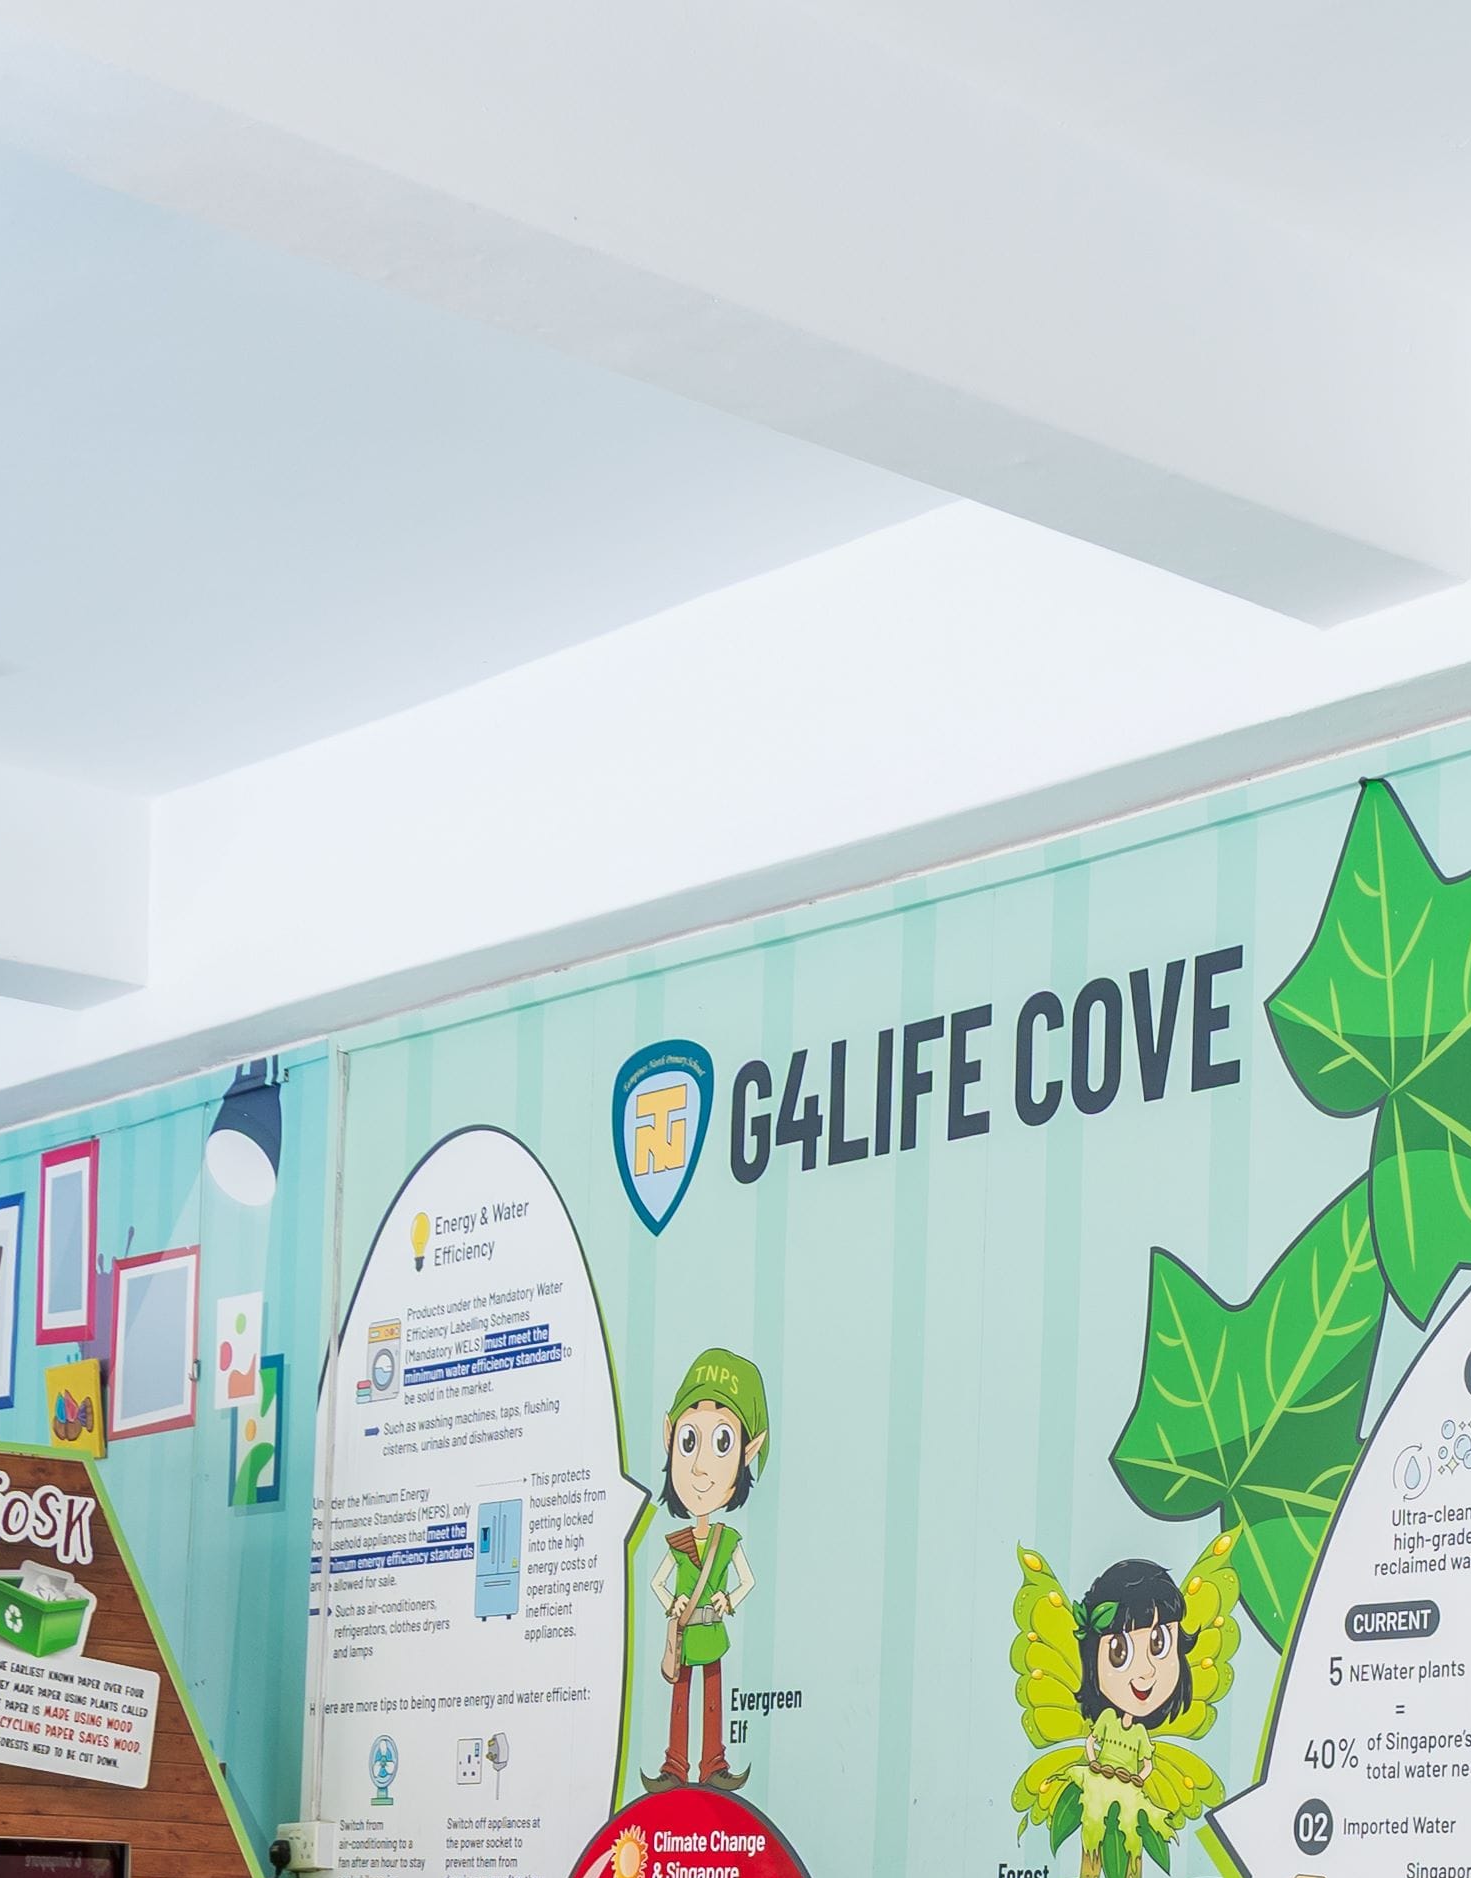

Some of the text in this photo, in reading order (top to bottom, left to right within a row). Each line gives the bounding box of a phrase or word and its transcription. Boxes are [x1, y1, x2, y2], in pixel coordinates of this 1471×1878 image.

[730, 945, 1243, 1184] G4LIFE COVE
[436, 1203, 529, 1235] Energy & Water
[435, 1241, 494, 1266] Efficiency
[695, 1364, 740, 1395] TNPS
[531, 1469, 590, 1487] This protects
[1353, 1609, 1431, 1633] CURRENT
[11, 1663, 44, 1677] EARLIEST
[49, 1672, 73, 1683] KNOWN
[78, 1677, 100, 1689] PAPER
[104, 1683, 122, 1694] OVER
[126, 1687, 144, 1698] FOUR
[731, 1689, 801, 1713] Evergreen
[731, 1720, 748, 1744] Elf
[1304, 1741, 1359, 1769] 40%
[1299, 1813, 1456, 1842] 02 Imported Water
[654, 1831, 765, 1856] Climate Change
